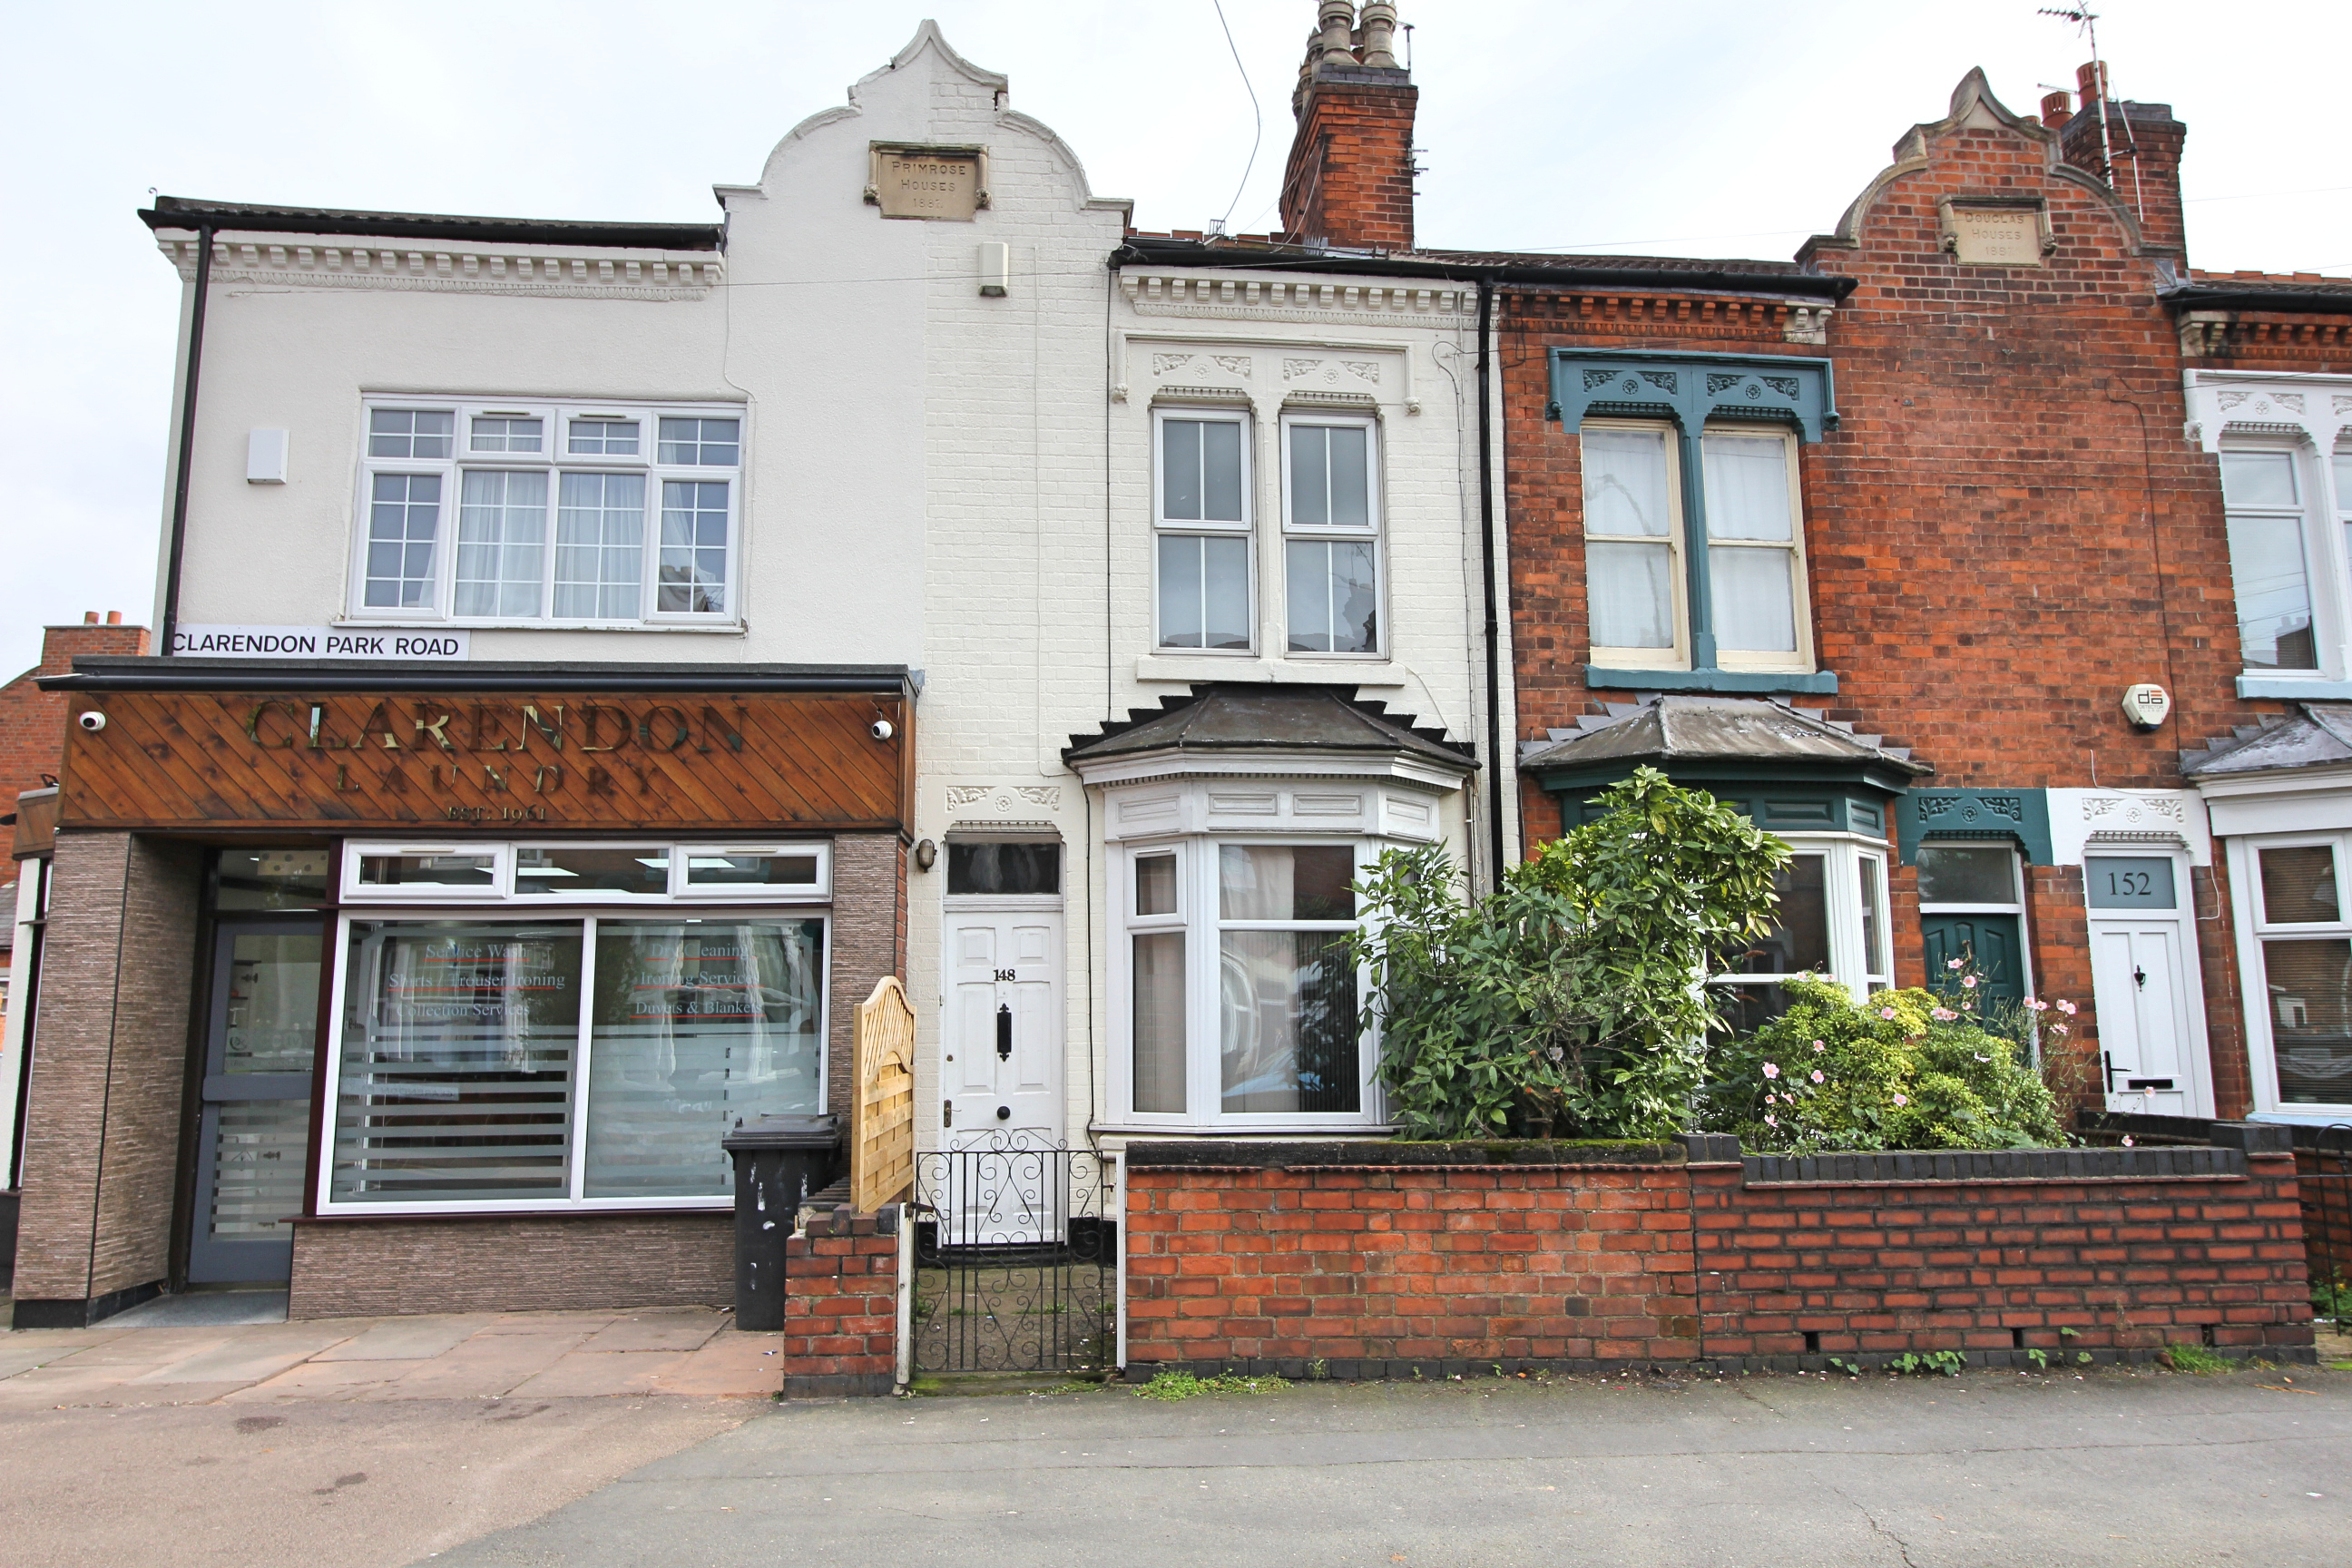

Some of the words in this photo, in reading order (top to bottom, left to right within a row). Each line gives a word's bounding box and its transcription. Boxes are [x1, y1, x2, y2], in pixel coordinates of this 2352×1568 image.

[892, 161, 965, 175] PRIMROSE
[901, 179, 956, 191] HOUSES
[1972, 229, 2022, 240] HOUSES
[172, 632, 316, 652] CLARENDON
[326, 635, 385, 654] PARK
[395, 637, 459, 656] ROAD
[245, 701, 748, 752] CLARENDON
[336, 763, 658, 794] LAUNDRY
[502, 804, 546, 826] 1961
[2108, 872, 2151, 896] 152
[425, 944, 482, 958] Service
[487, 944, 529, 958] Wash
[652, 943, 679, 961] Dry
[684, 943, 749, 960] Cleaning
[388, 974, 433, 988] Shirts
[449, 974, 507, 987] Trouser
[512, 973, 565, 990] Ironing
[641, 971, 694, 987] Ironing
[993, 969, 1015, 981] 148
[397, 1004, 468, 1017] Collection
[472, 1003, 530, 1016] Services
[636, 1001, 682, 1014] Duvets
[686, 1002, 700, 1014] &
[703, 1001, 762, 1014] Blankets
